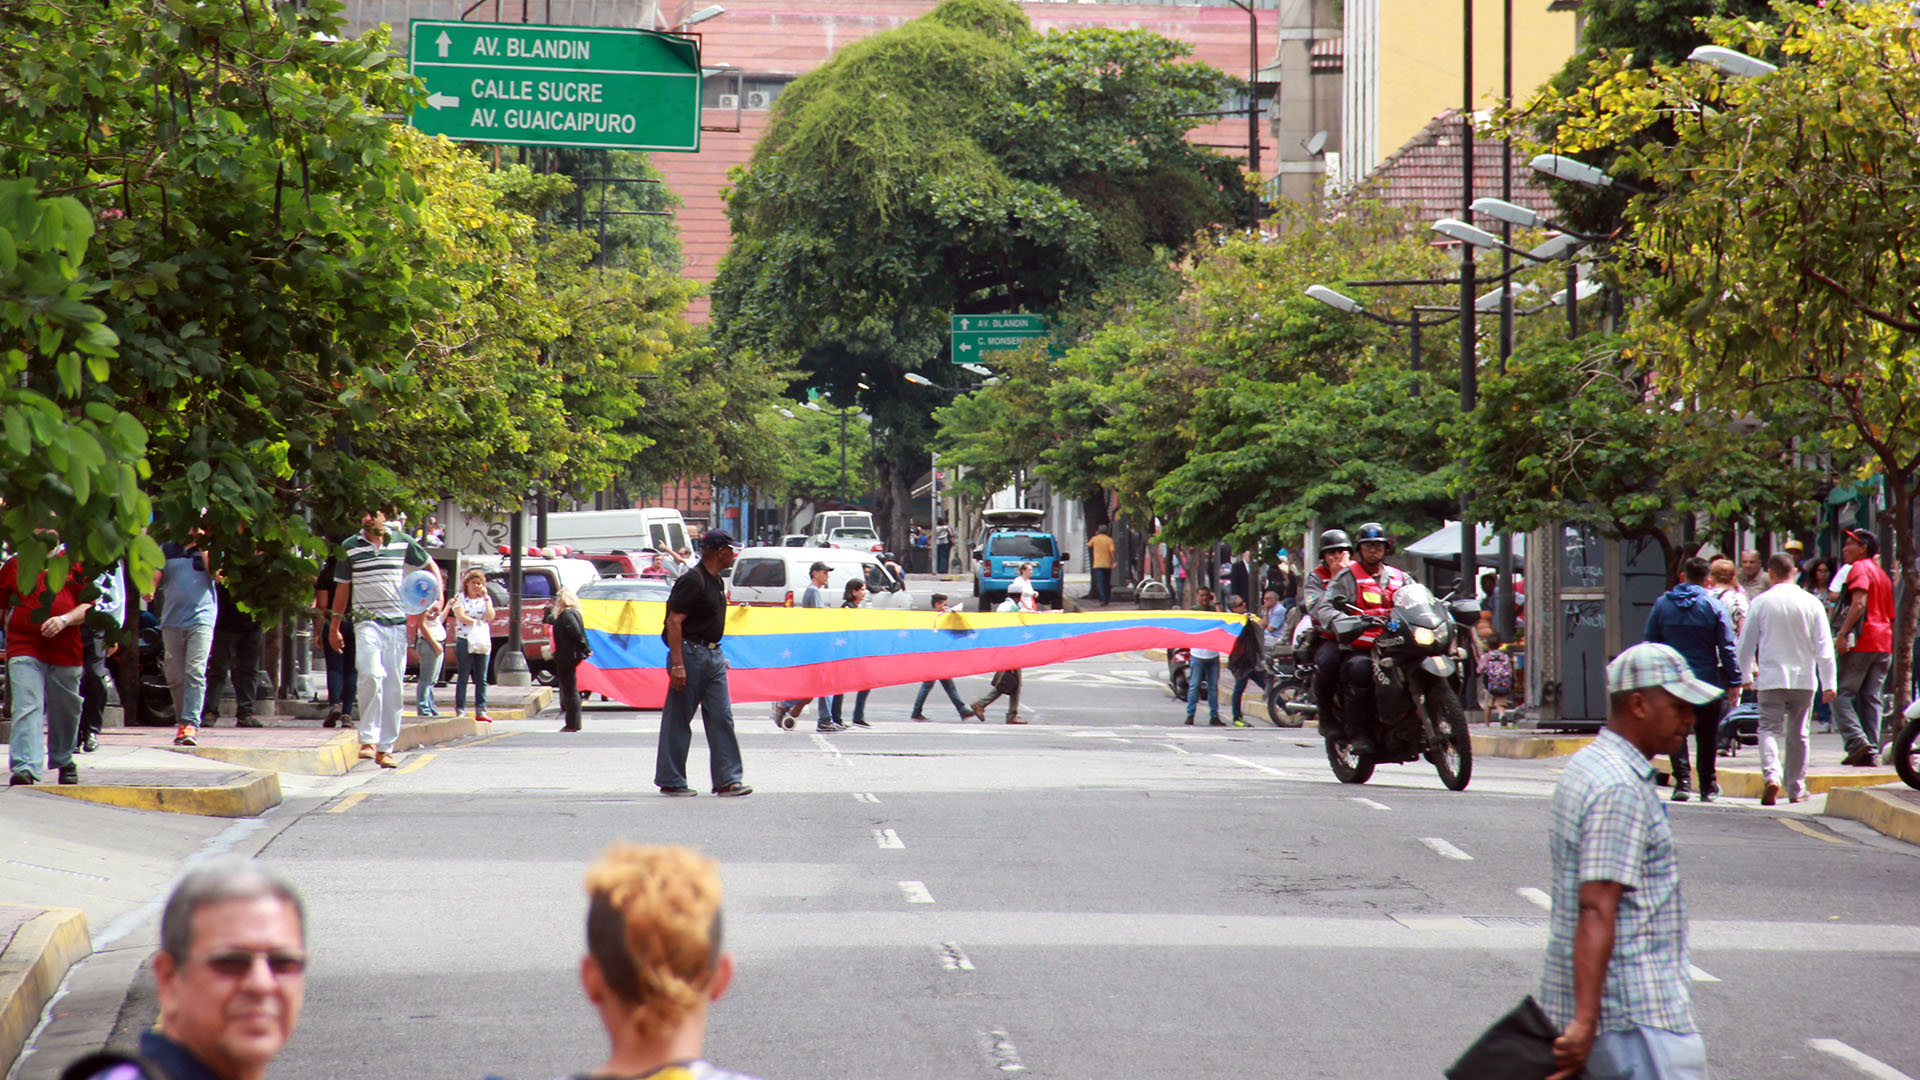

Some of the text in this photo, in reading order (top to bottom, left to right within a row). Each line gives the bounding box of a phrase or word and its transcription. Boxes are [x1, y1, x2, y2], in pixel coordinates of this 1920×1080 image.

[472, 36, 590, 60] AV. BLANDIN
[471, 78, 603, 103] CALLE SUCRE
[470, 108, 636, 134] AV. GUAICAIPURO
[977, 319, 1028, 328] AV. BLANDIN
